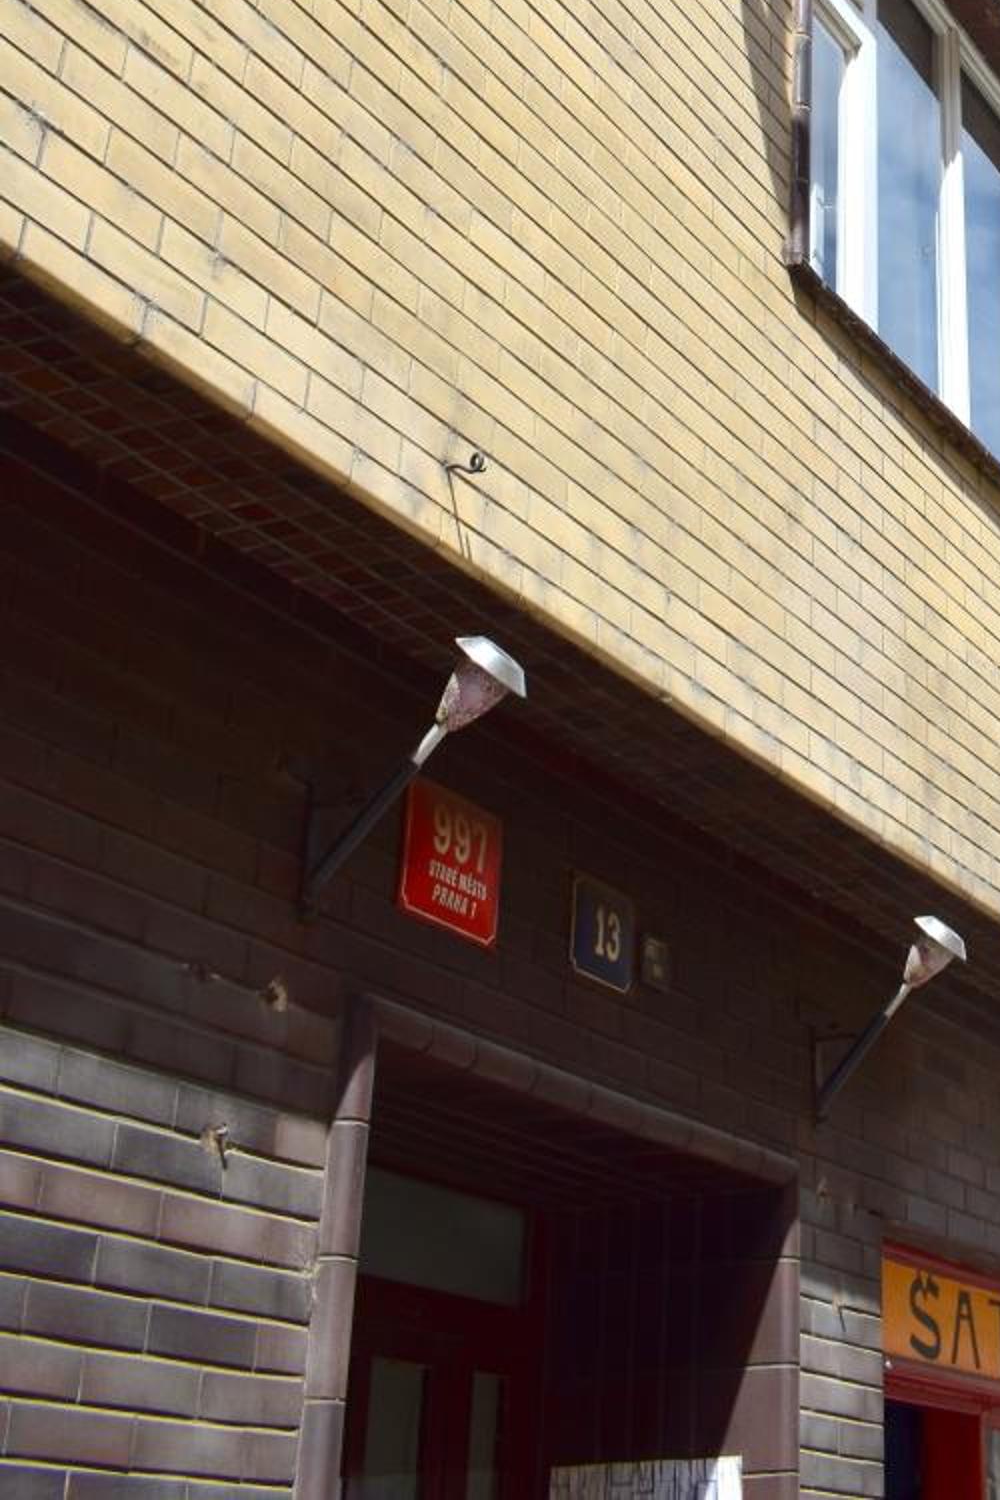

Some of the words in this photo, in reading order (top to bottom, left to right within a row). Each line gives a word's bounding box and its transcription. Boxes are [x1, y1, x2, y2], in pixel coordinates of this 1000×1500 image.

[433, 803, 487, 874] 997
[431, 883, 468, 916] PRAHA
[470, 900, 478, 920] 1
[594, 900, 621, 962] 13
